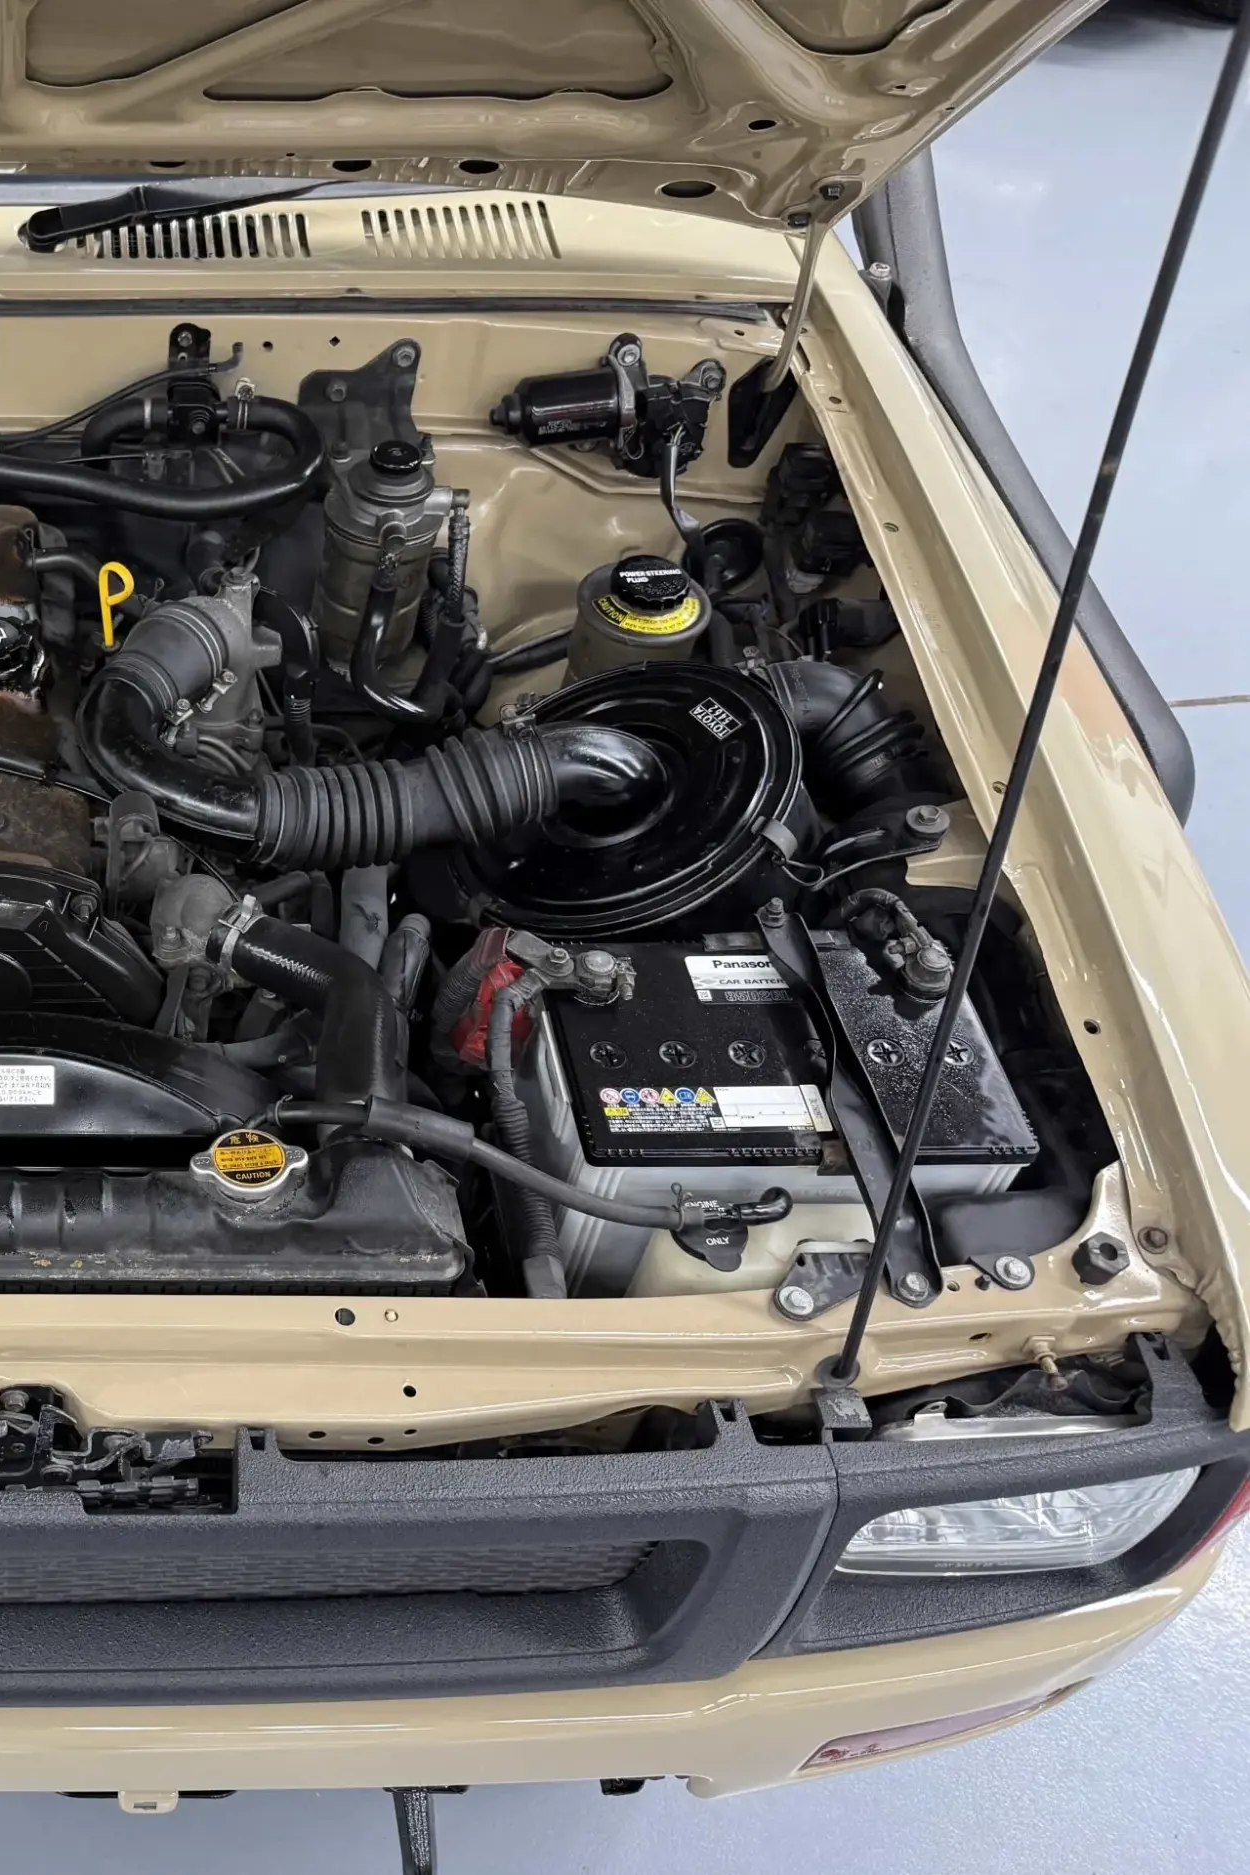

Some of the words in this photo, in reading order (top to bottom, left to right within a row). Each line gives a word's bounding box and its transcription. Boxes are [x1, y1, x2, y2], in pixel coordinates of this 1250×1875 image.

[619, 570, 645, 578] POWER
[646, 568, 682, 577] STEERING
[626, 576, 649, 584] FLUID
[597, 597, 625, 623] CAUTION
[707, 704, 732, 725] 5462
[693, 706, 728, 737] TOYOTA
[712, 960, 774, 969] Panason
[235, 1170, 271, 1181] CAUTION
[705, 1236, 730, 1246] ONLY
